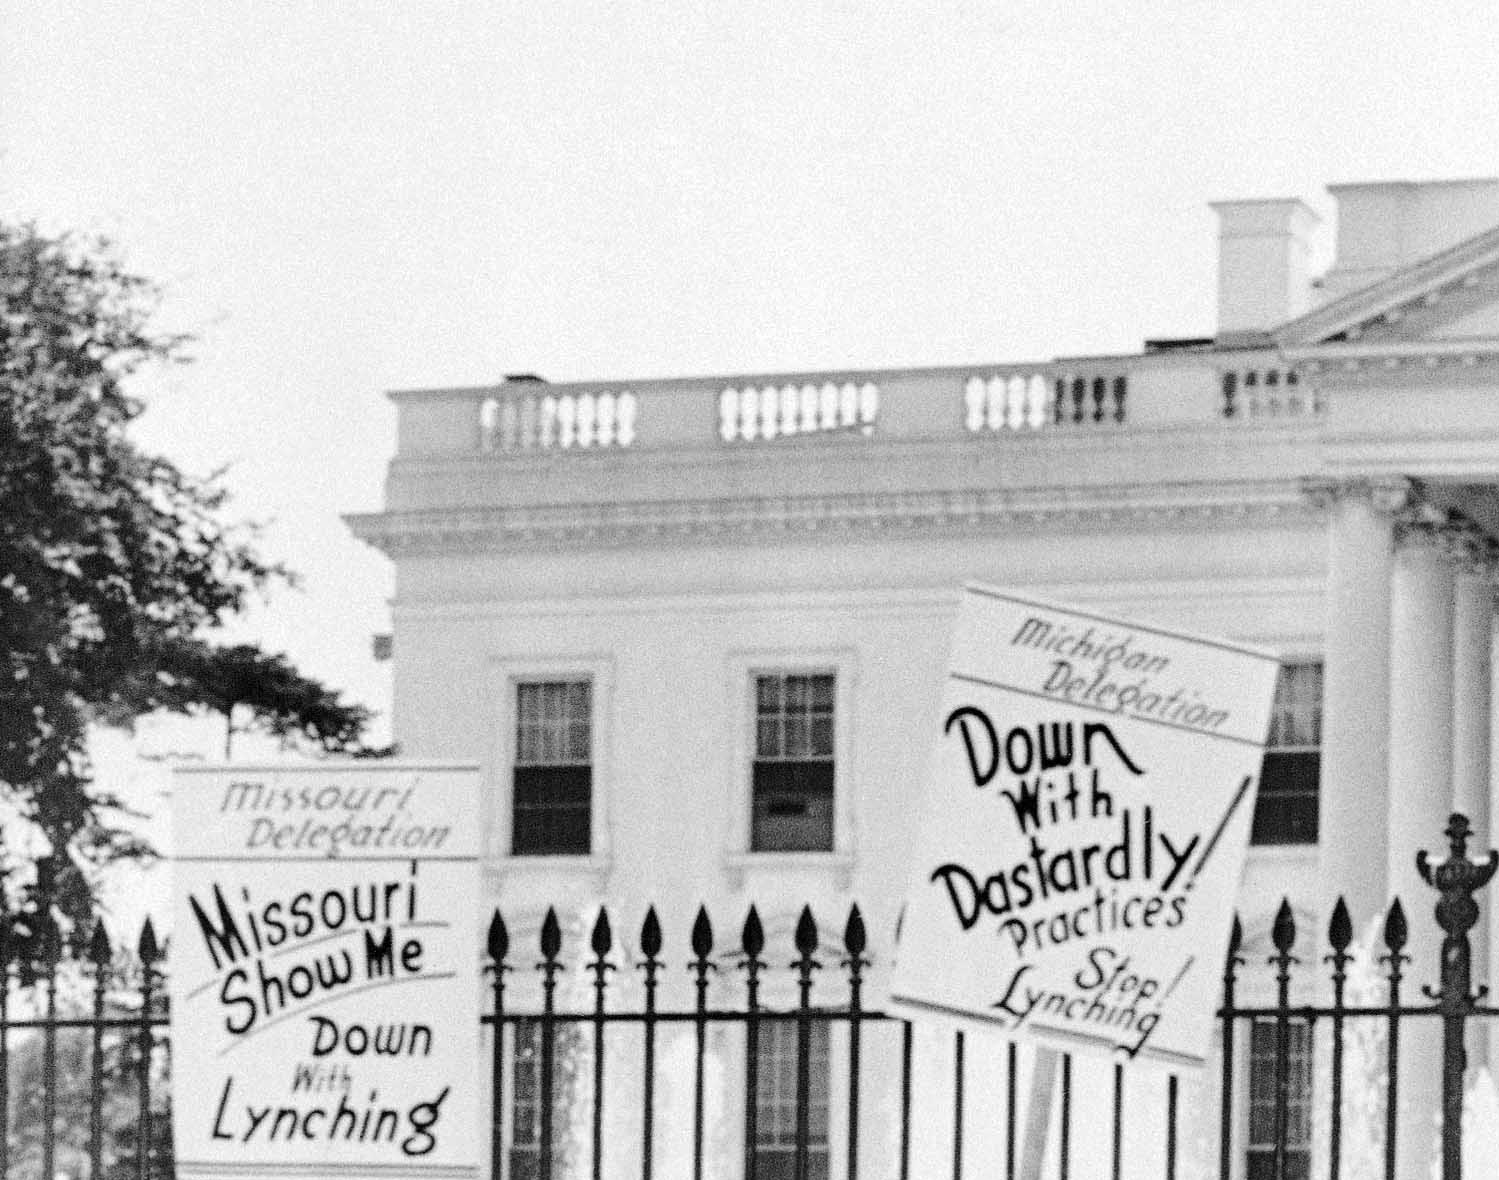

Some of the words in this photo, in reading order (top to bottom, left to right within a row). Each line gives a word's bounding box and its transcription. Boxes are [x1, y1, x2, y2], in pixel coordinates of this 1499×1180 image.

[1012, 617, 1169, 672] Michigan
[1043, 660, 1229, 728] Delegation
[945, 706, 1146, 786] Down
[1001, 769, 1113, 834] With
[246, 815, 451, 858] Delegation
[187, 859, 418, 970] Missouri
[220, 948, 352, 1034] Show
[364, 926, 423, 979] Me
[309, 1016, 432, 1056] Down
[292, 1062, 352, 1092] With
[212, 1076, 450, 1155] Lynching
